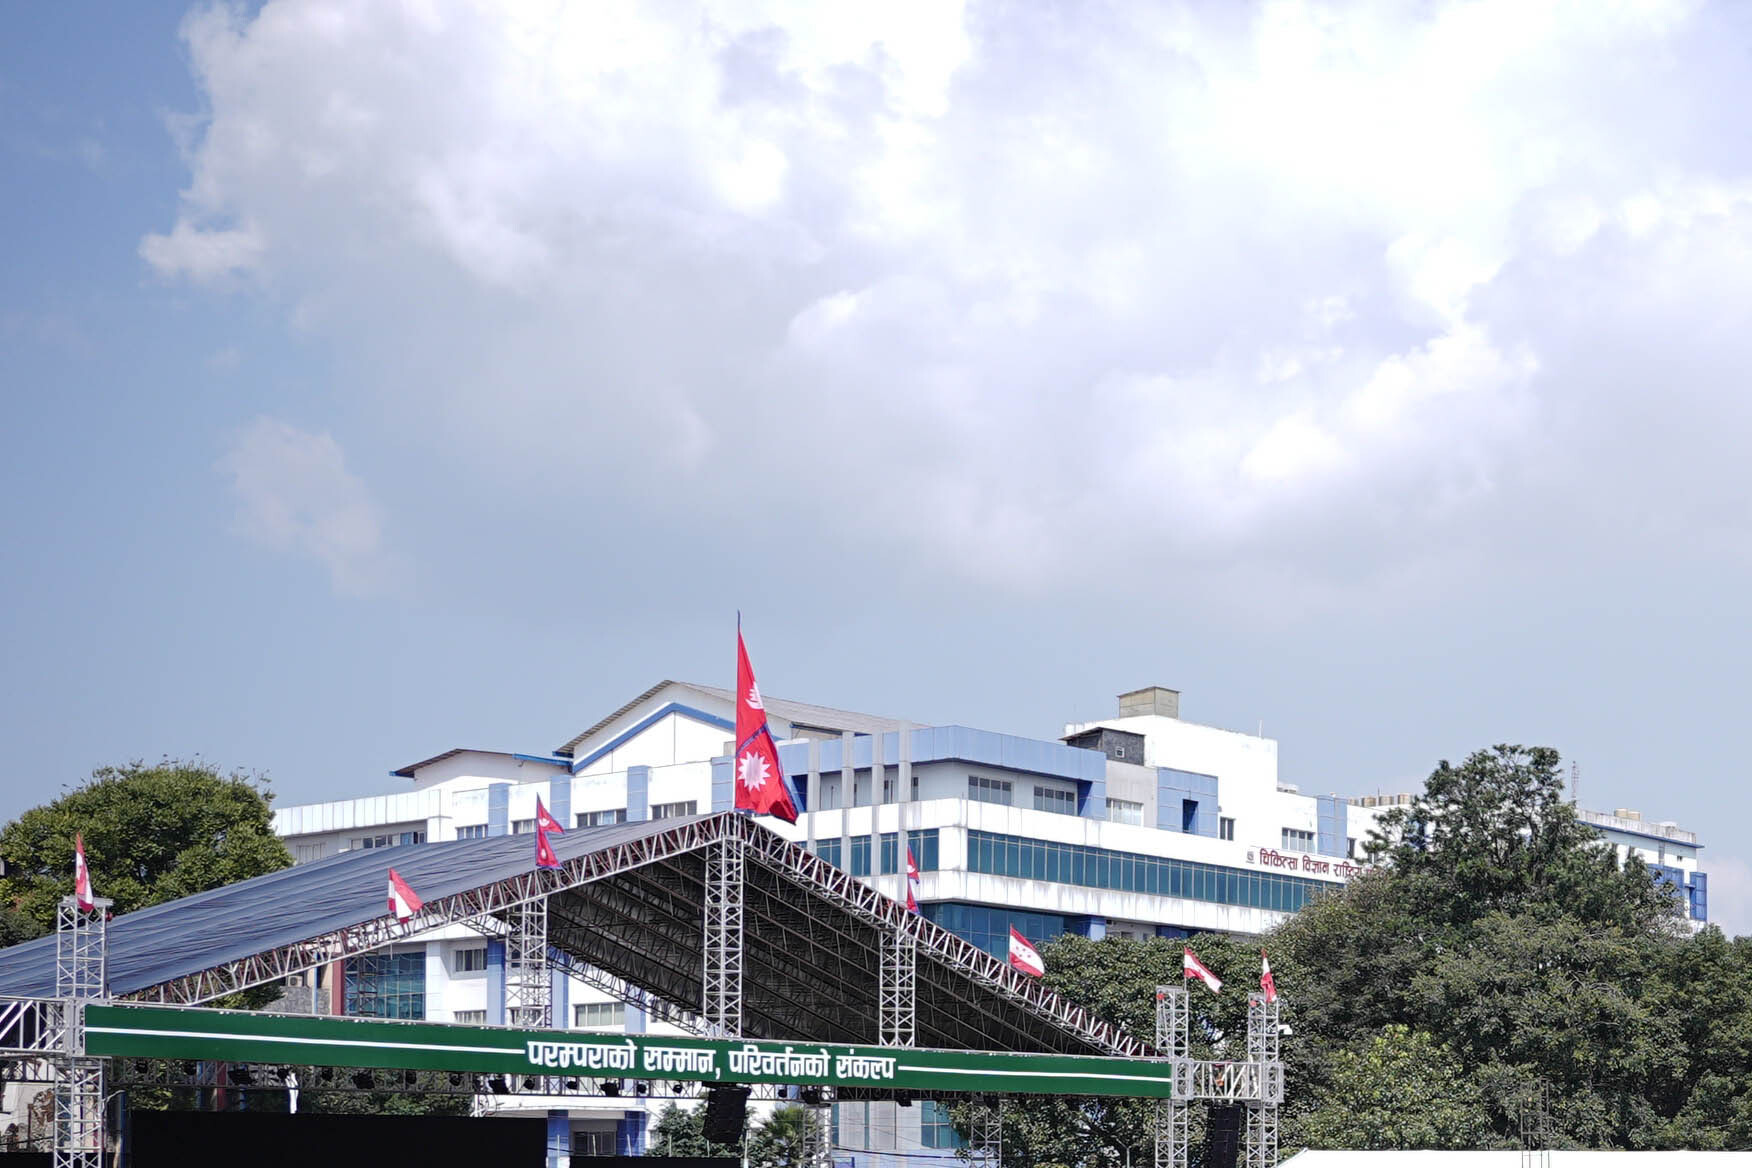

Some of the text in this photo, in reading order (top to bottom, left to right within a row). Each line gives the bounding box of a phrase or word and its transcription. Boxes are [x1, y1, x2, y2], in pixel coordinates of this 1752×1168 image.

[1259, 848, 1298, 871] चिकित्सा
[1302, 855, 1329, 874] विज्ञान
[526, 1038, 896, 1080] परम्पराको सम्मान, परिवर्तनको संकल्प
